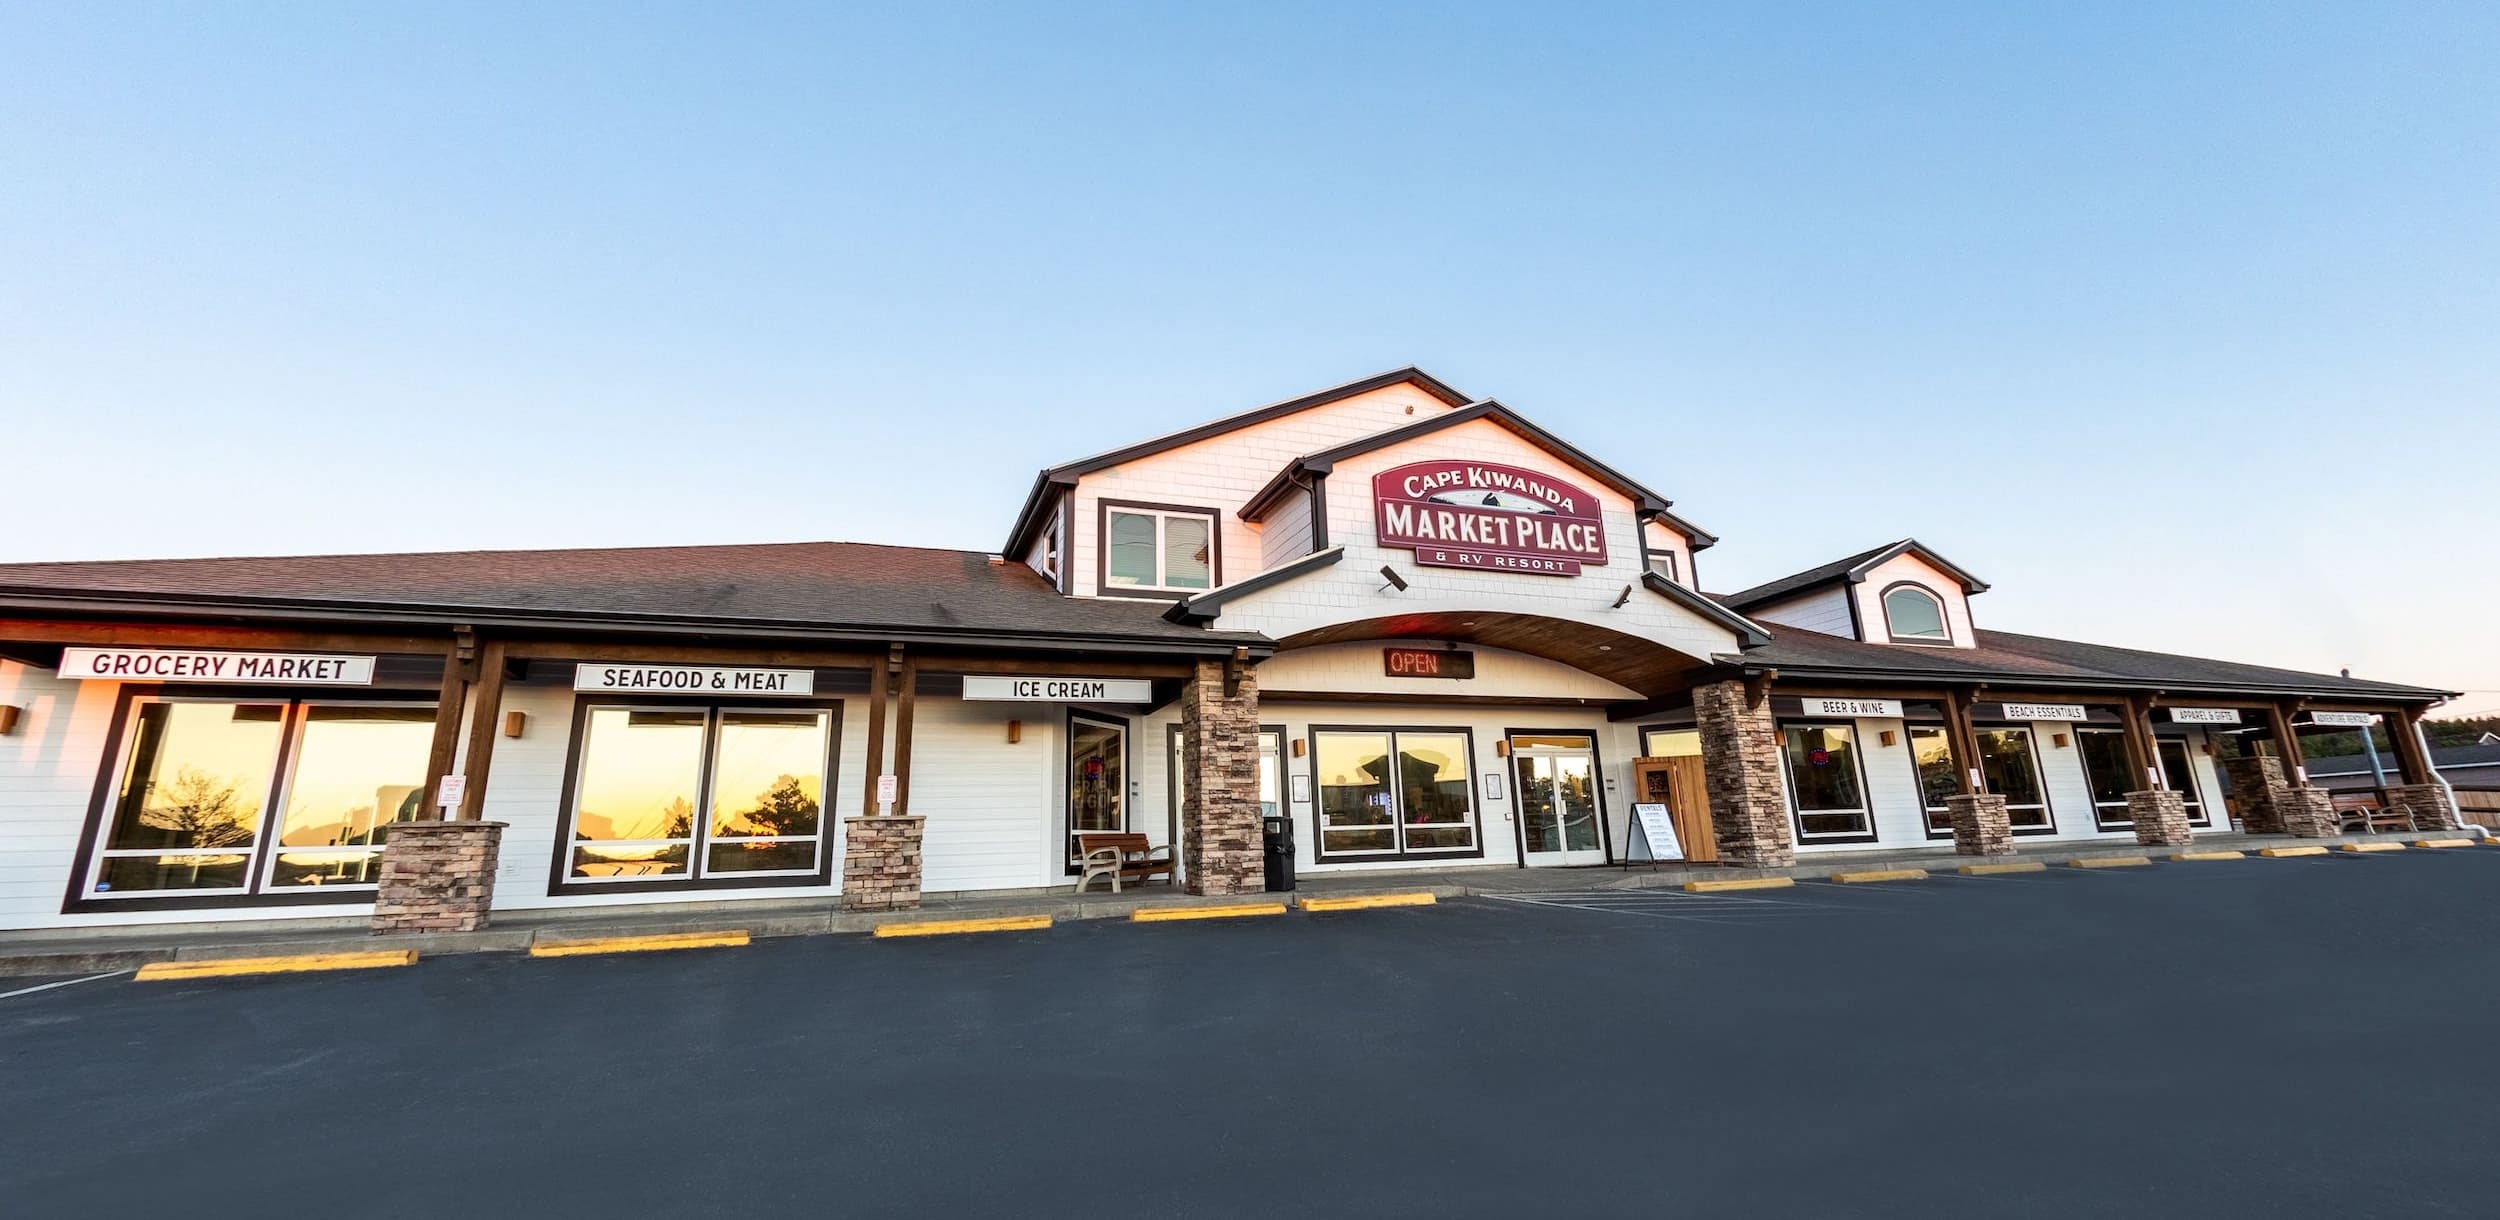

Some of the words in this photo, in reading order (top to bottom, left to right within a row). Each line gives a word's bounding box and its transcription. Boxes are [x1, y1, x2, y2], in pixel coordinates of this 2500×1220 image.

[1404, 470, 1464, 498] CAPE
[1467, 467, 1575, 514] KIWANDA
[1384, 502, 1509, 546] MARKET
[1515, 515, 1601, 553] PLACE
[1436, 551, 1446, 561] &
[1459, 553, 1483, 565] RV
[1495, 557, 1566, 571] RESORT
[93, 654, 228, 677] GROCERY
[237, 657, 347, 680] MARKET
[1390, 652, 1438, 673] OPEN
[603, 668, 703, 689] SEAFOOD
[711, 672, 726, 689] &
[734, 671, 788, 691] MEAT
[1013, 680, 1040, 697] ICE
[1047, 681, 1105, 698] CREAM
[1823, 701, 1847, 712] BEER
[1850, 702, 1857, 712] &
[1859, 702, 1884, 713] WINE
[2009, 706, 2034, 717] BEACH
[2036, 707, 2080, 718] ESSENTIALS
